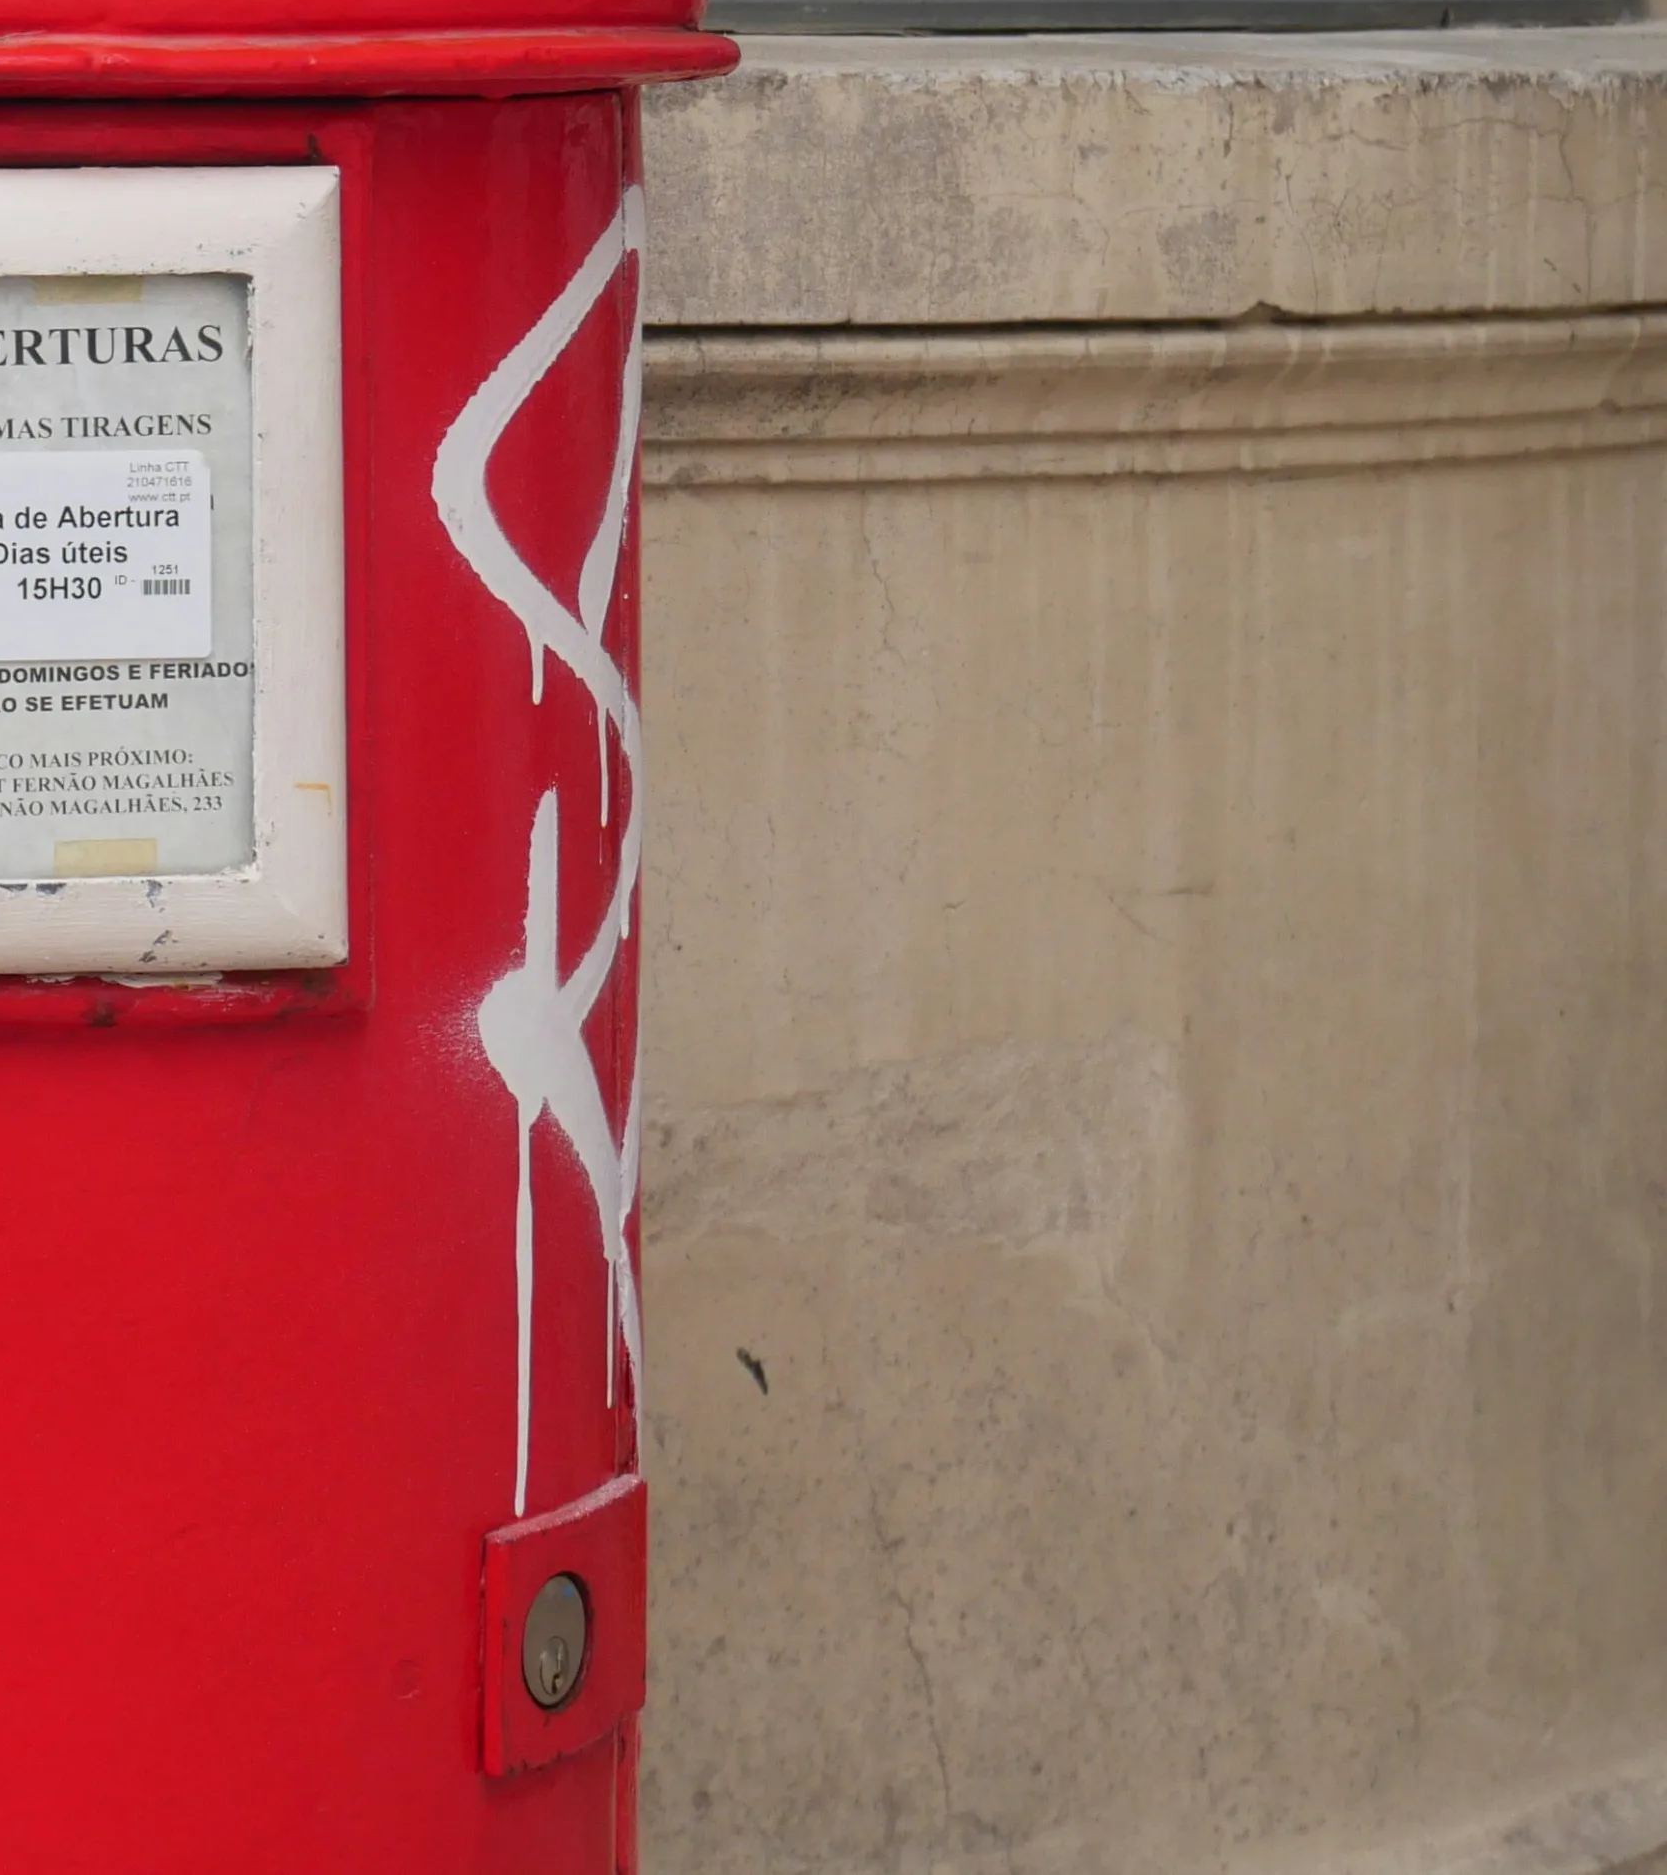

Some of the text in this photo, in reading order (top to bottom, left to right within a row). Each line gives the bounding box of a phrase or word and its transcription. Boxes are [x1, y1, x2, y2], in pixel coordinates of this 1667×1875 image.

[61, 414, 212, 438] TIRAGENS
[129, 460, 189, 474] Linha CTT
[126, 475, 192, 488] 210471616
[14, 506, 48, 530] de
[57, 505, 180, 529] Abertura
[61, 540, 128, 565] úteis
[152, 564, 178, 575] 1251
[17, 576, 102, 601] 15H30
[114, 574, 128, 586] ID
[128, 663, 142, 681] E
[25, 695, 53, 713] SE
[61, 692, 169, 712] EFETUAM
[30, 752, 82, 768] MAIS
[88, 746, 194, 767] PRÓXIMO:
[13, 773, 97, 793] FERNÃO
[102, 770, 235, 790] MAGALHÃES
[50, 794, 188, 816] MAGALHÃES,
[193, 795, 223, 811] 233
